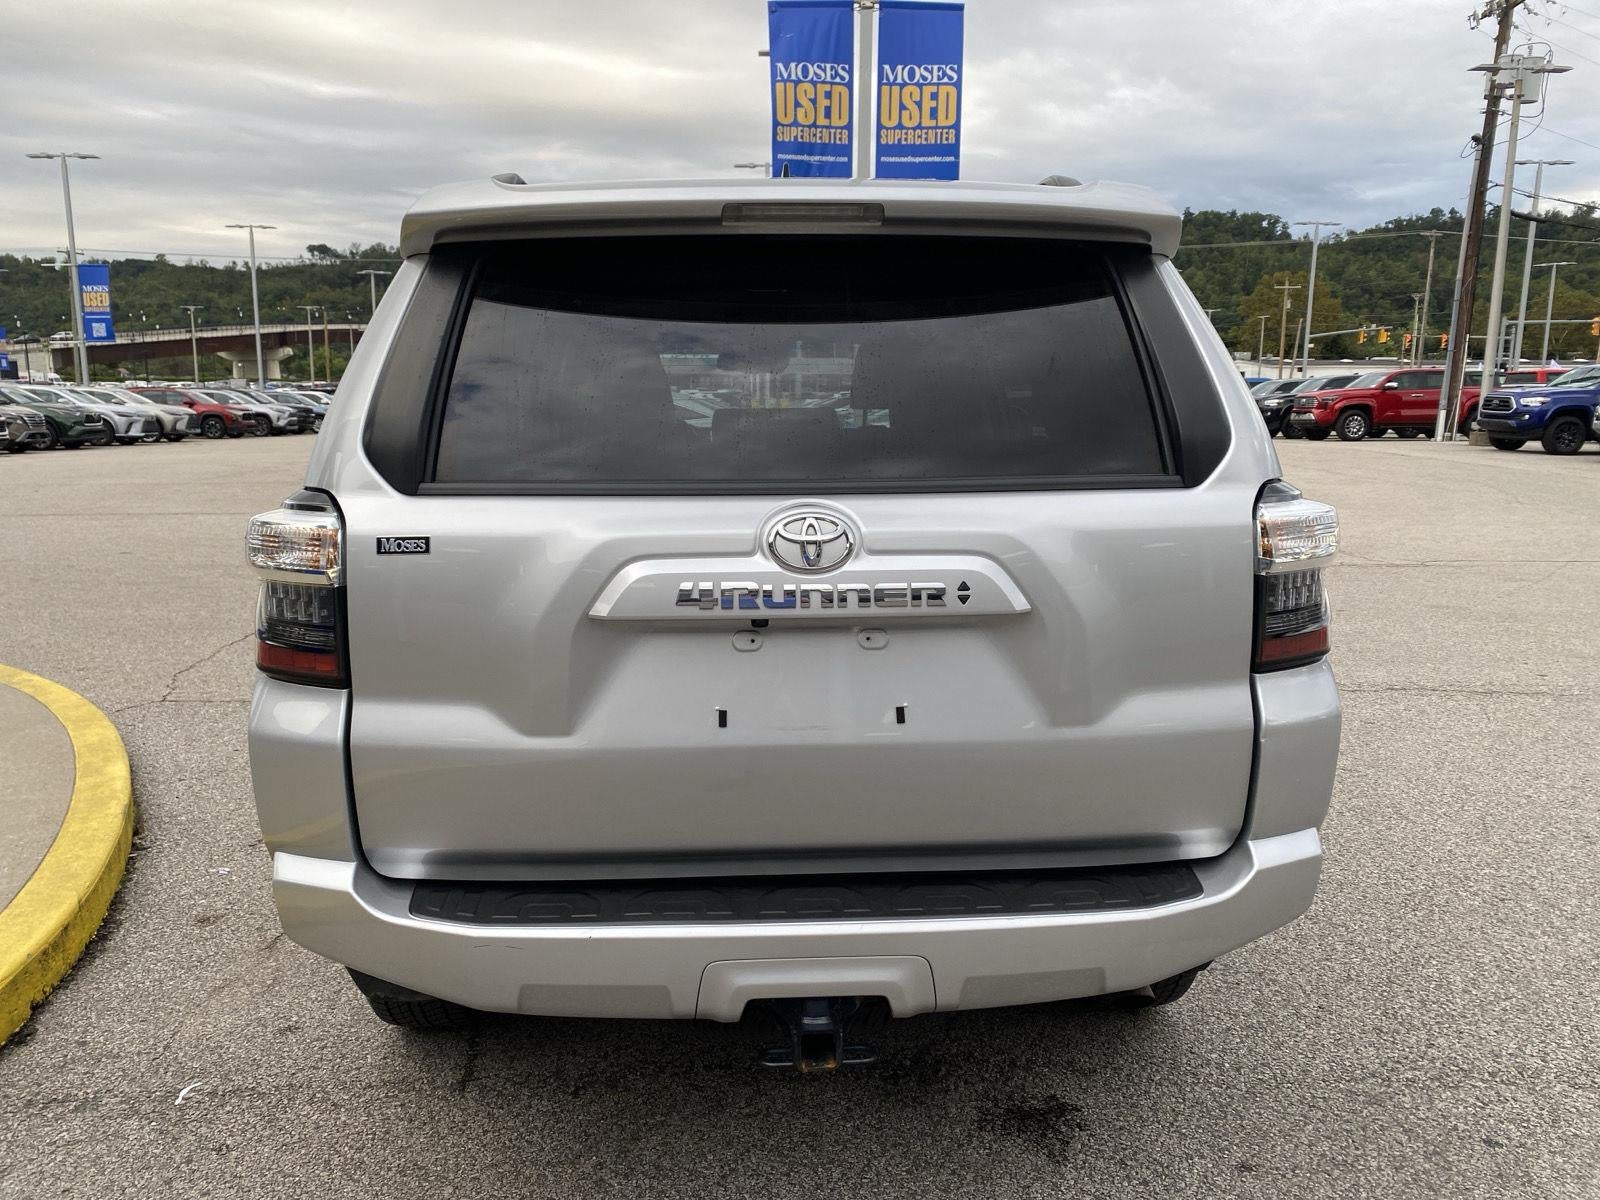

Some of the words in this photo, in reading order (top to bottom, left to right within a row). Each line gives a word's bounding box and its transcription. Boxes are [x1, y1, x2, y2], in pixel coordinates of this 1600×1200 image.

[776, 62, 850, 83] MOSES
[881, 64, 958, 84] MOSES
[775, 82, 850, 126] USED
[880, 85, 958, 128] USED
[777, 126, 849, 145] SUPERCENTER
[880, 128, 956, 145] SUPERCENTER
[777, 153, 849, 162] mosesusedsupercenter.com
[880, 155, 956, 163] mosesusedsupercenter.com
[82, 292, 110, 307] USED
